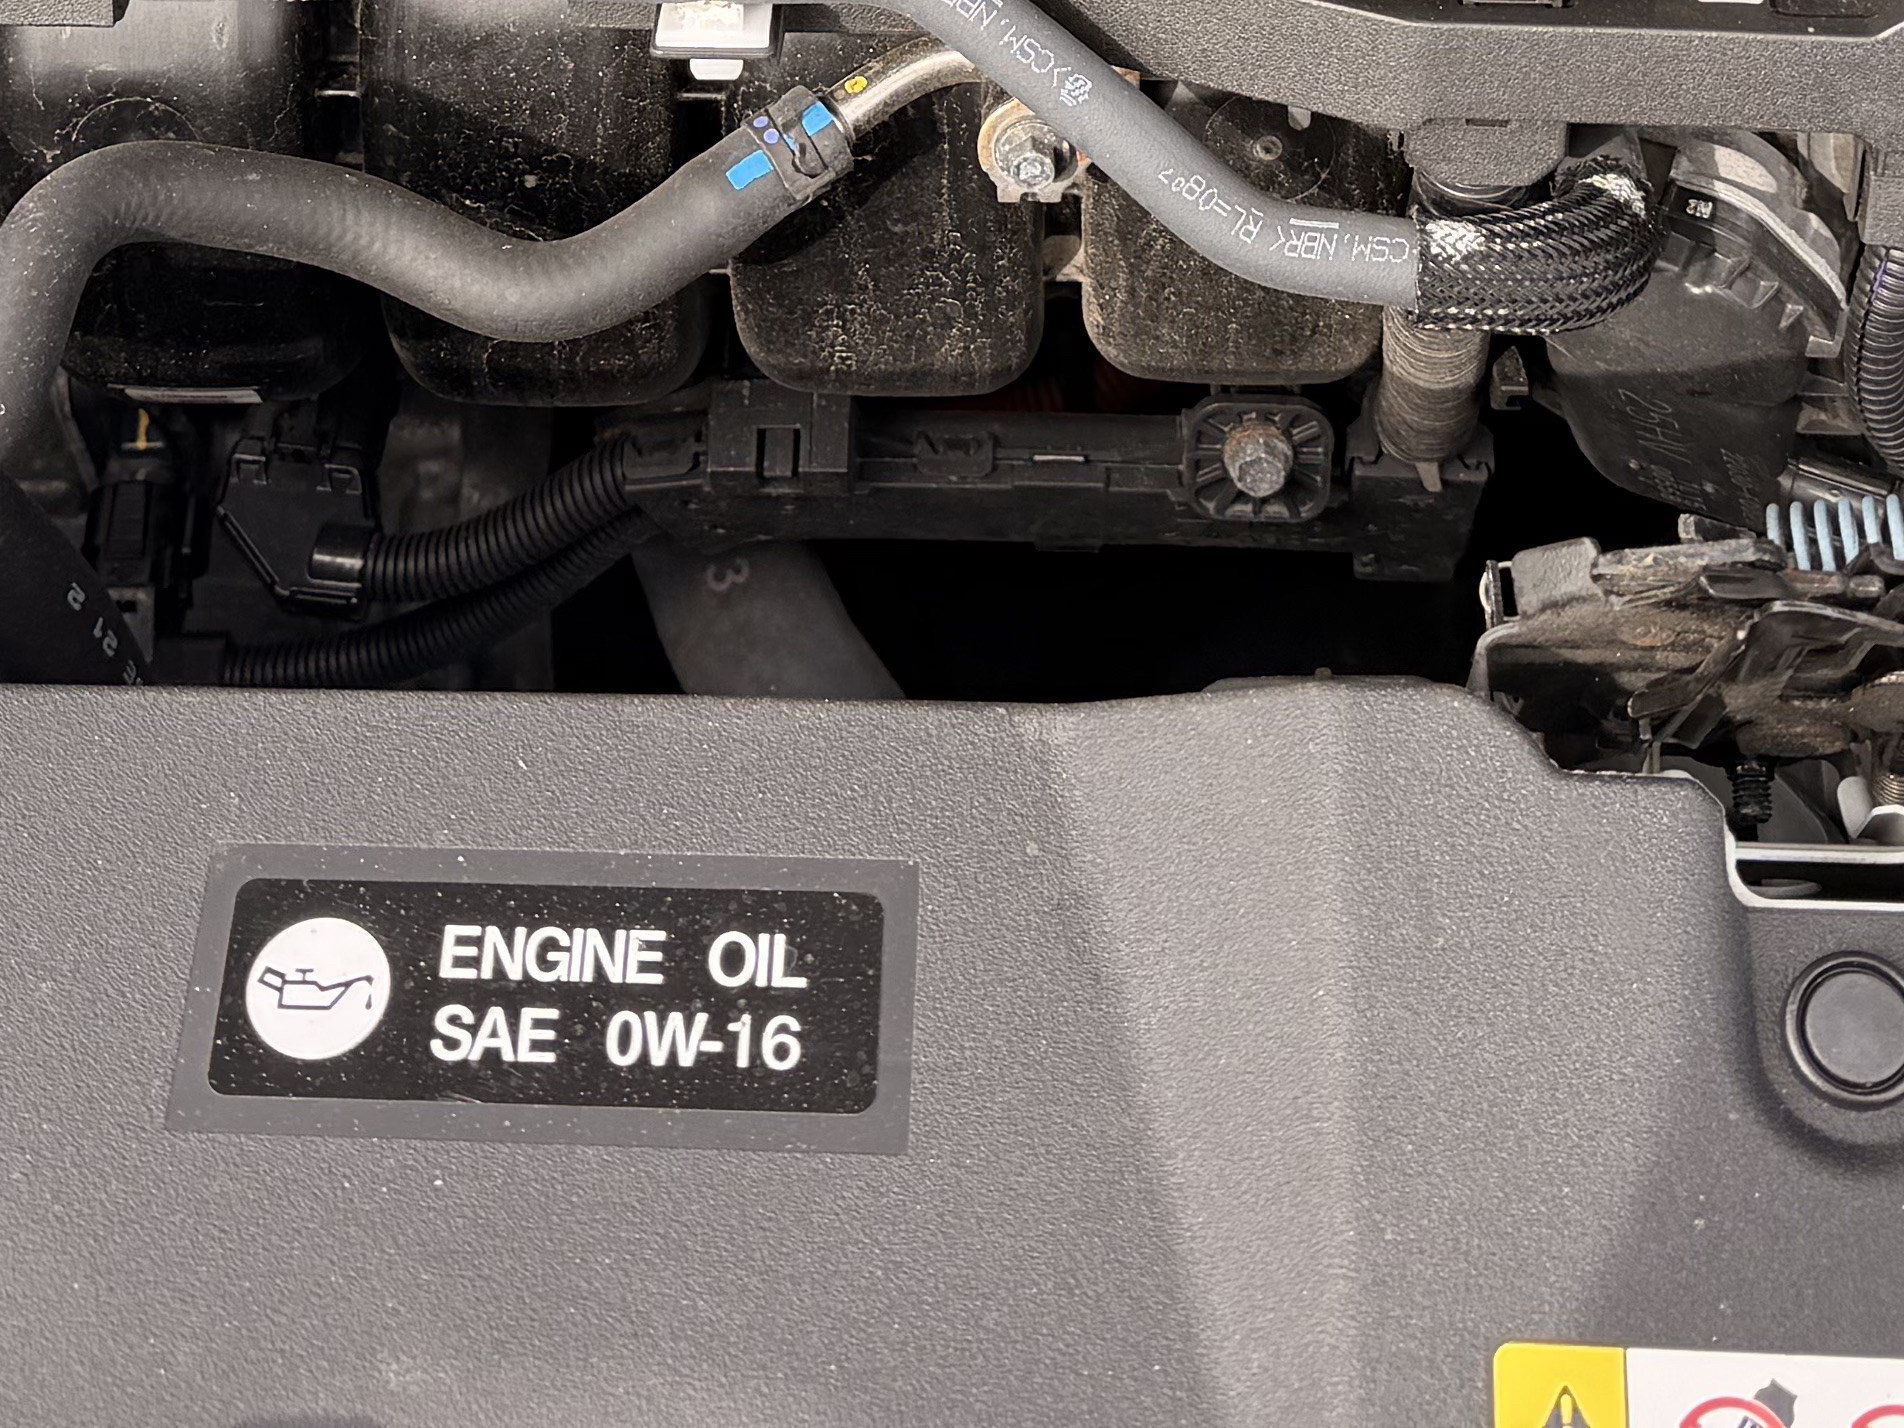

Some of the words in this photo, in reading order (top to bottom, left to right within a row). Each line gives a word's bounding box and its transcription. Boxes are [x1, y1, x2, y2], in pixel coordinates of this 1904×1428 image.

[439, 924, 666, 987] ENGINE
[707, 932, 810, 991] OIL
[429, 1006, 559, 1065] SAE
[605, 1011, 802, 1073] 0W-16
